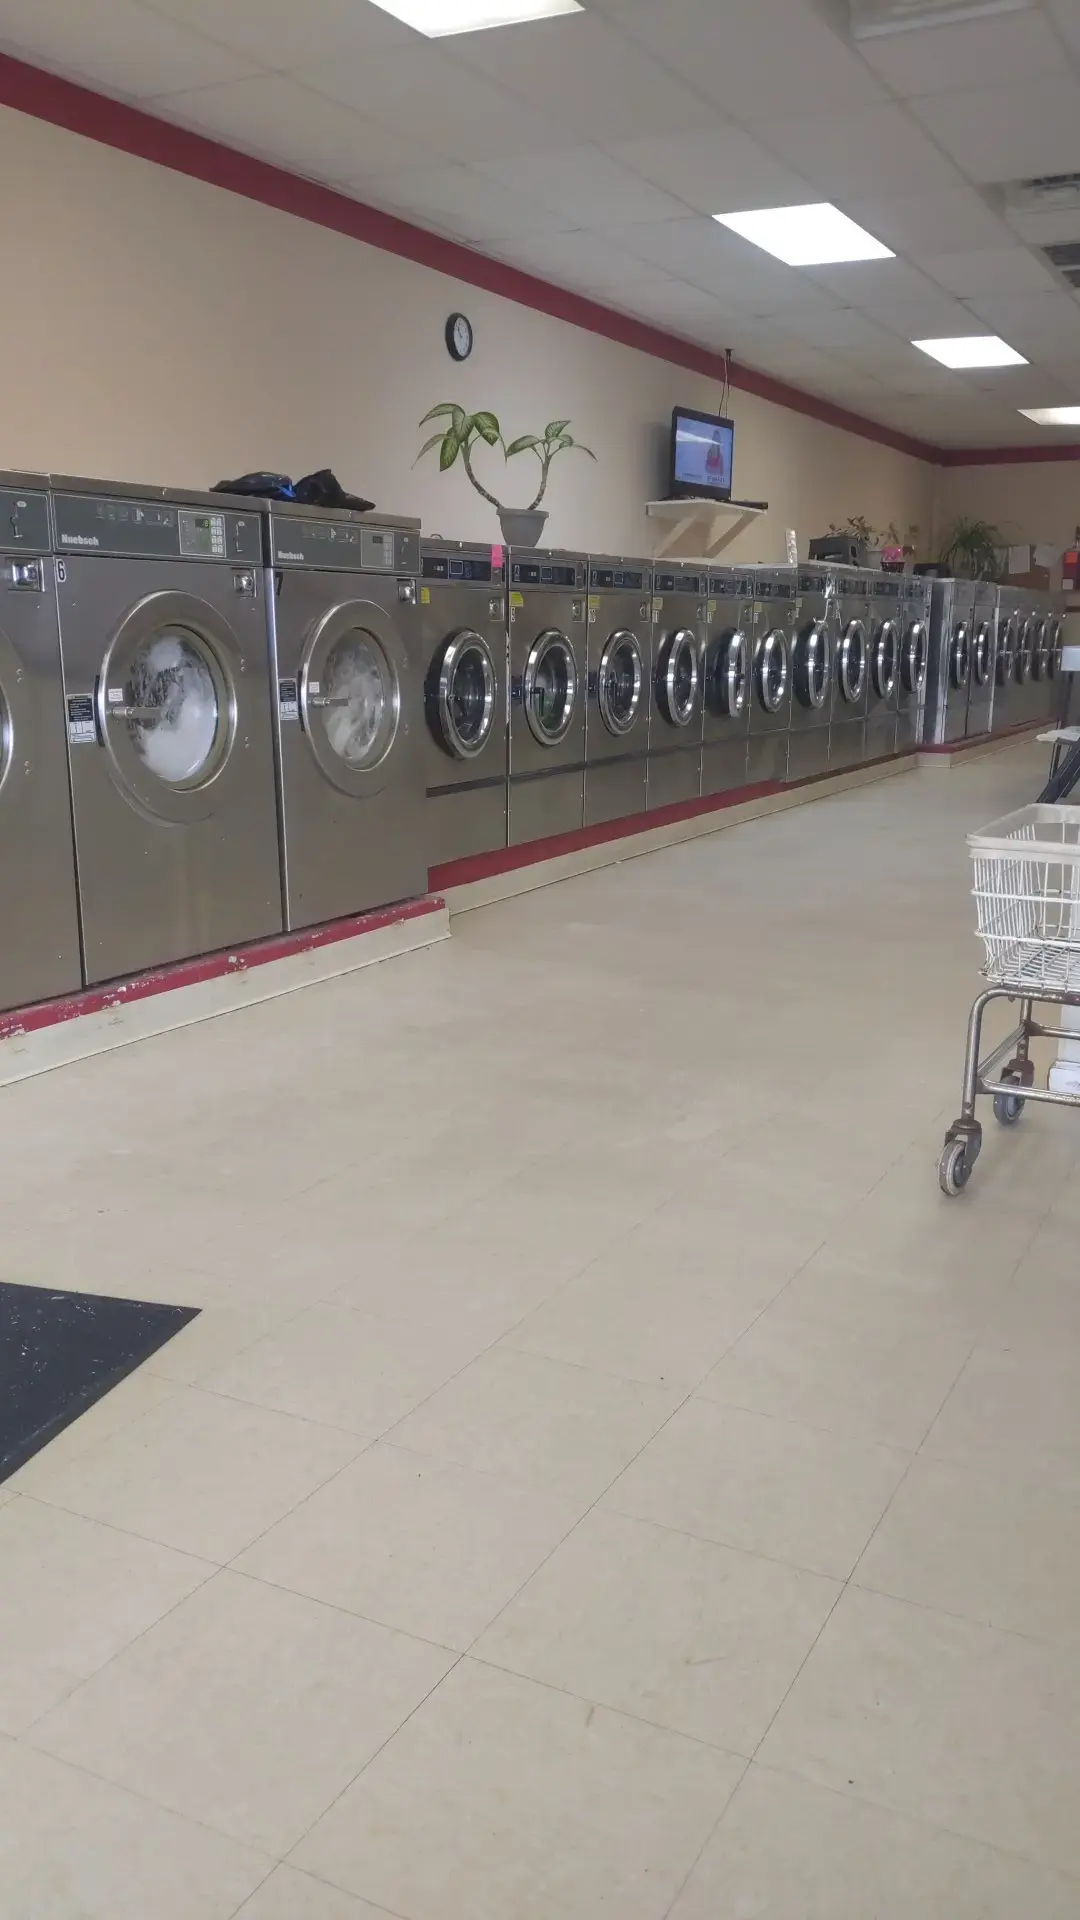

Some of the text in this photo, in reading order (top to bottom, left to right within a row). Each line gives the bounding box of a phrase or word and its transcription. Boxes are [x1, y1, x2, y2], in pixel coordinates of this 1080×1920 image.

[61, 534, 99, 546] Huebsch
[277, 550, 304, 560] Huebsch
[57, 560, 65, 581] 6
